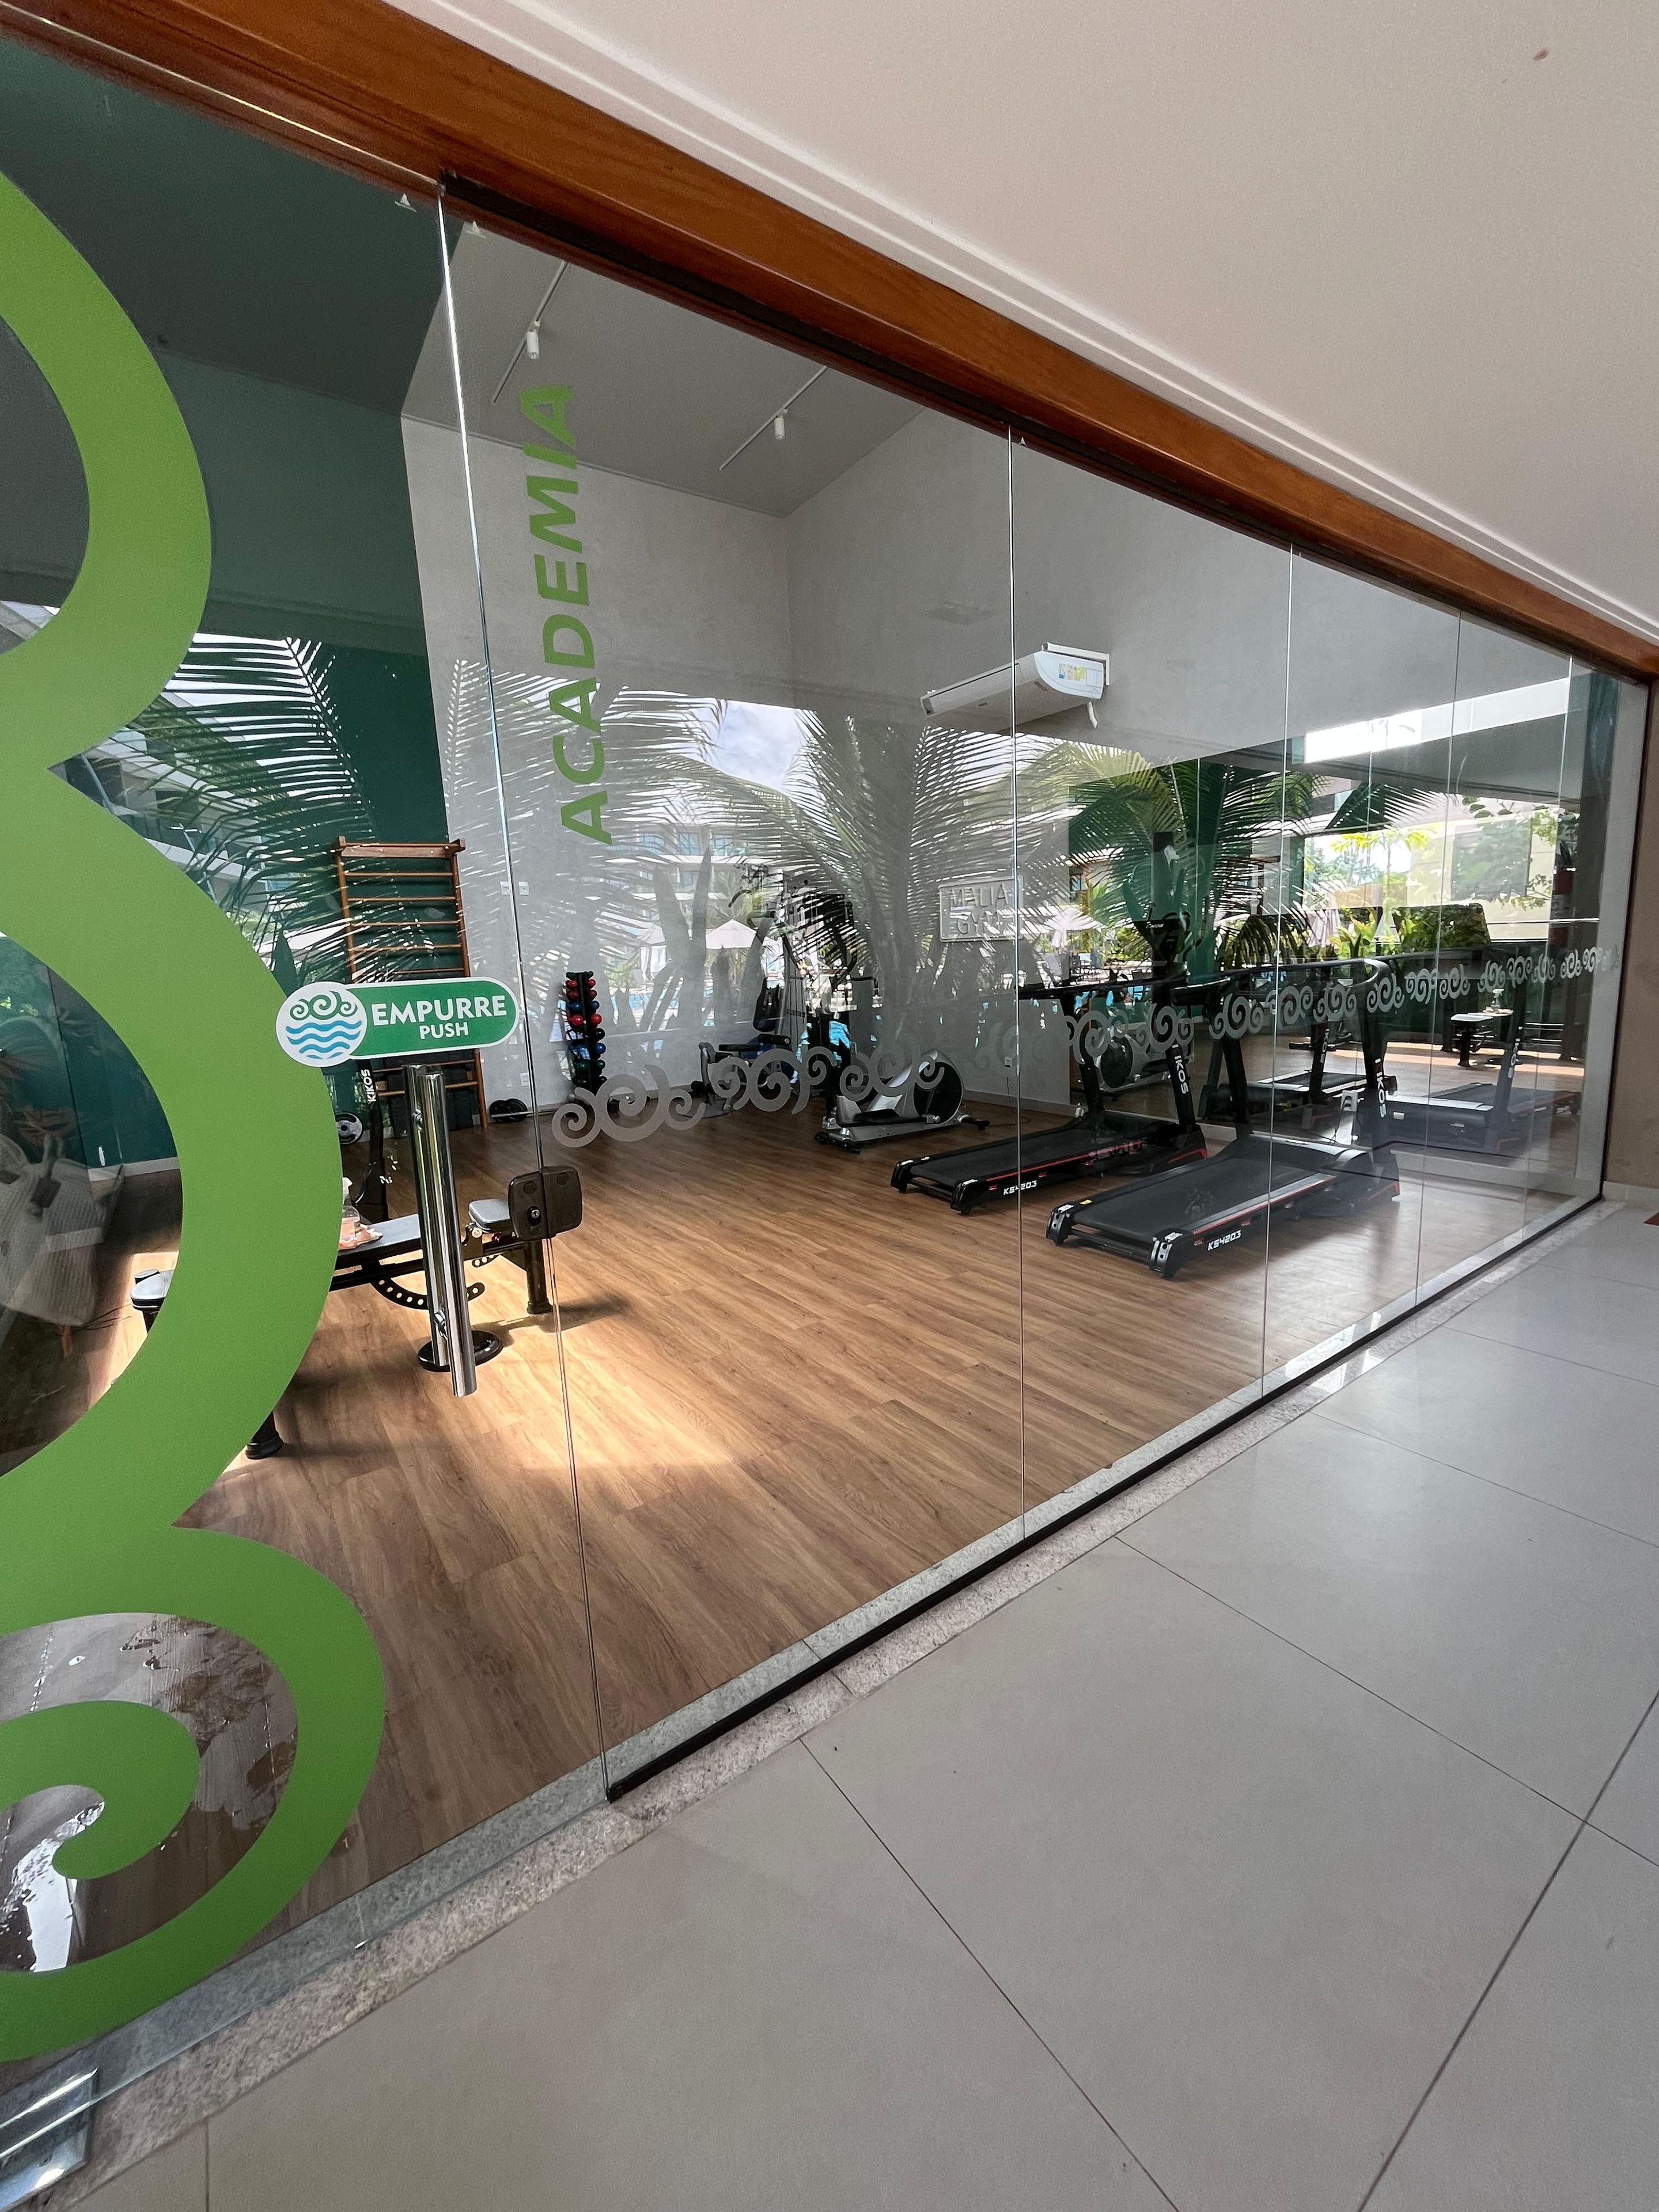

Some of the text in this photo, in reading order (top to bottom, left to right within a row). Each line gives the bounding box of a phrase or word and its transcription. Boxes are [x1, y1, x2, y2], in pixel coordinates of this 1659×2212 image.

[520, 384, 612, 845] ACADEMIA
[950, 882, 1009, 907] MALIA
[370, 995, 507, 1027] EMPURRE
[418, 1021, 469, 1040] PUSH
[361, 1069, 376, 1102] KIKOS
